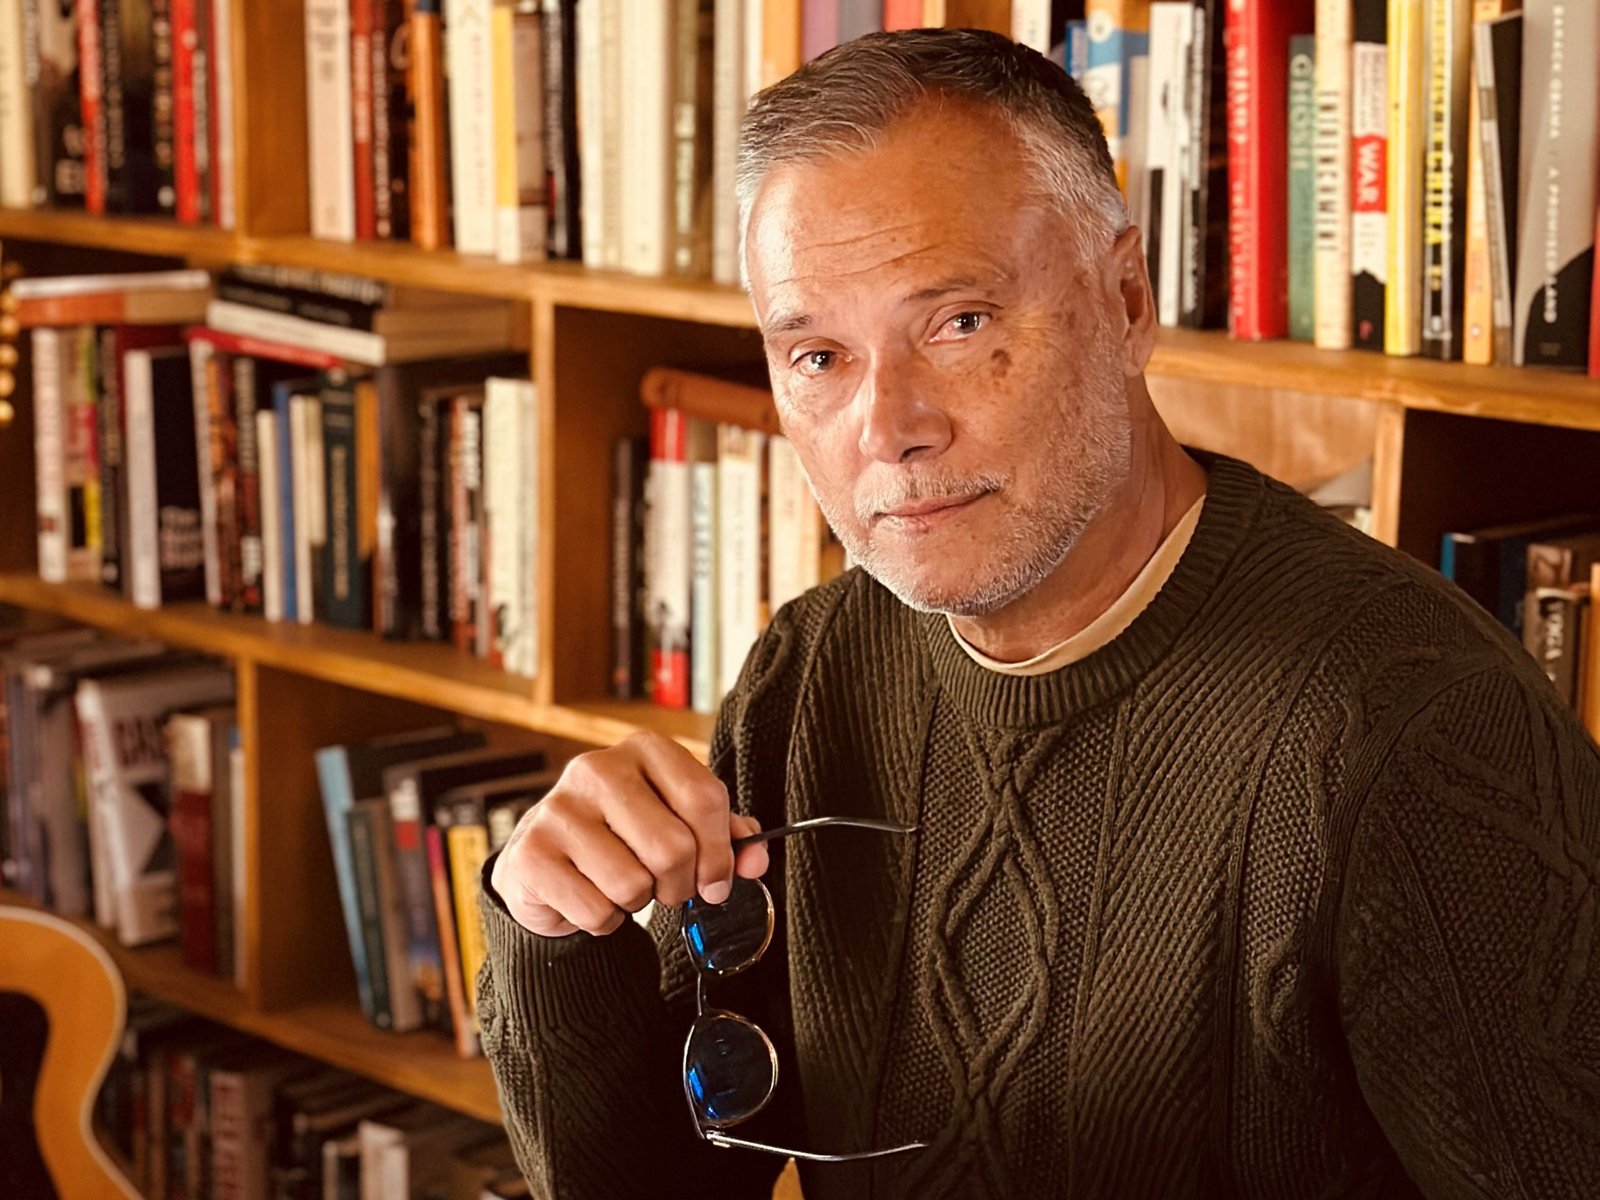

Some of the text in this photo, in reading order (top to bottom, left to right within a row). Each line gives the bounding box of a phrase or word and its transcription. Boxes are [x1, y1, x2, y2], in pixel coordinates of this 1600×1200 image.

[1551, 4, 1564, 72] BARACK
[1549, 77, 1563, 140] OBAMA
[1357, 139, 1380, 204] WAR
[1426, 150, 1453, 245] CHINA
[1546, 184, 1560, 272] PROMISED
[1544, 276, 1557, 323] LAND
